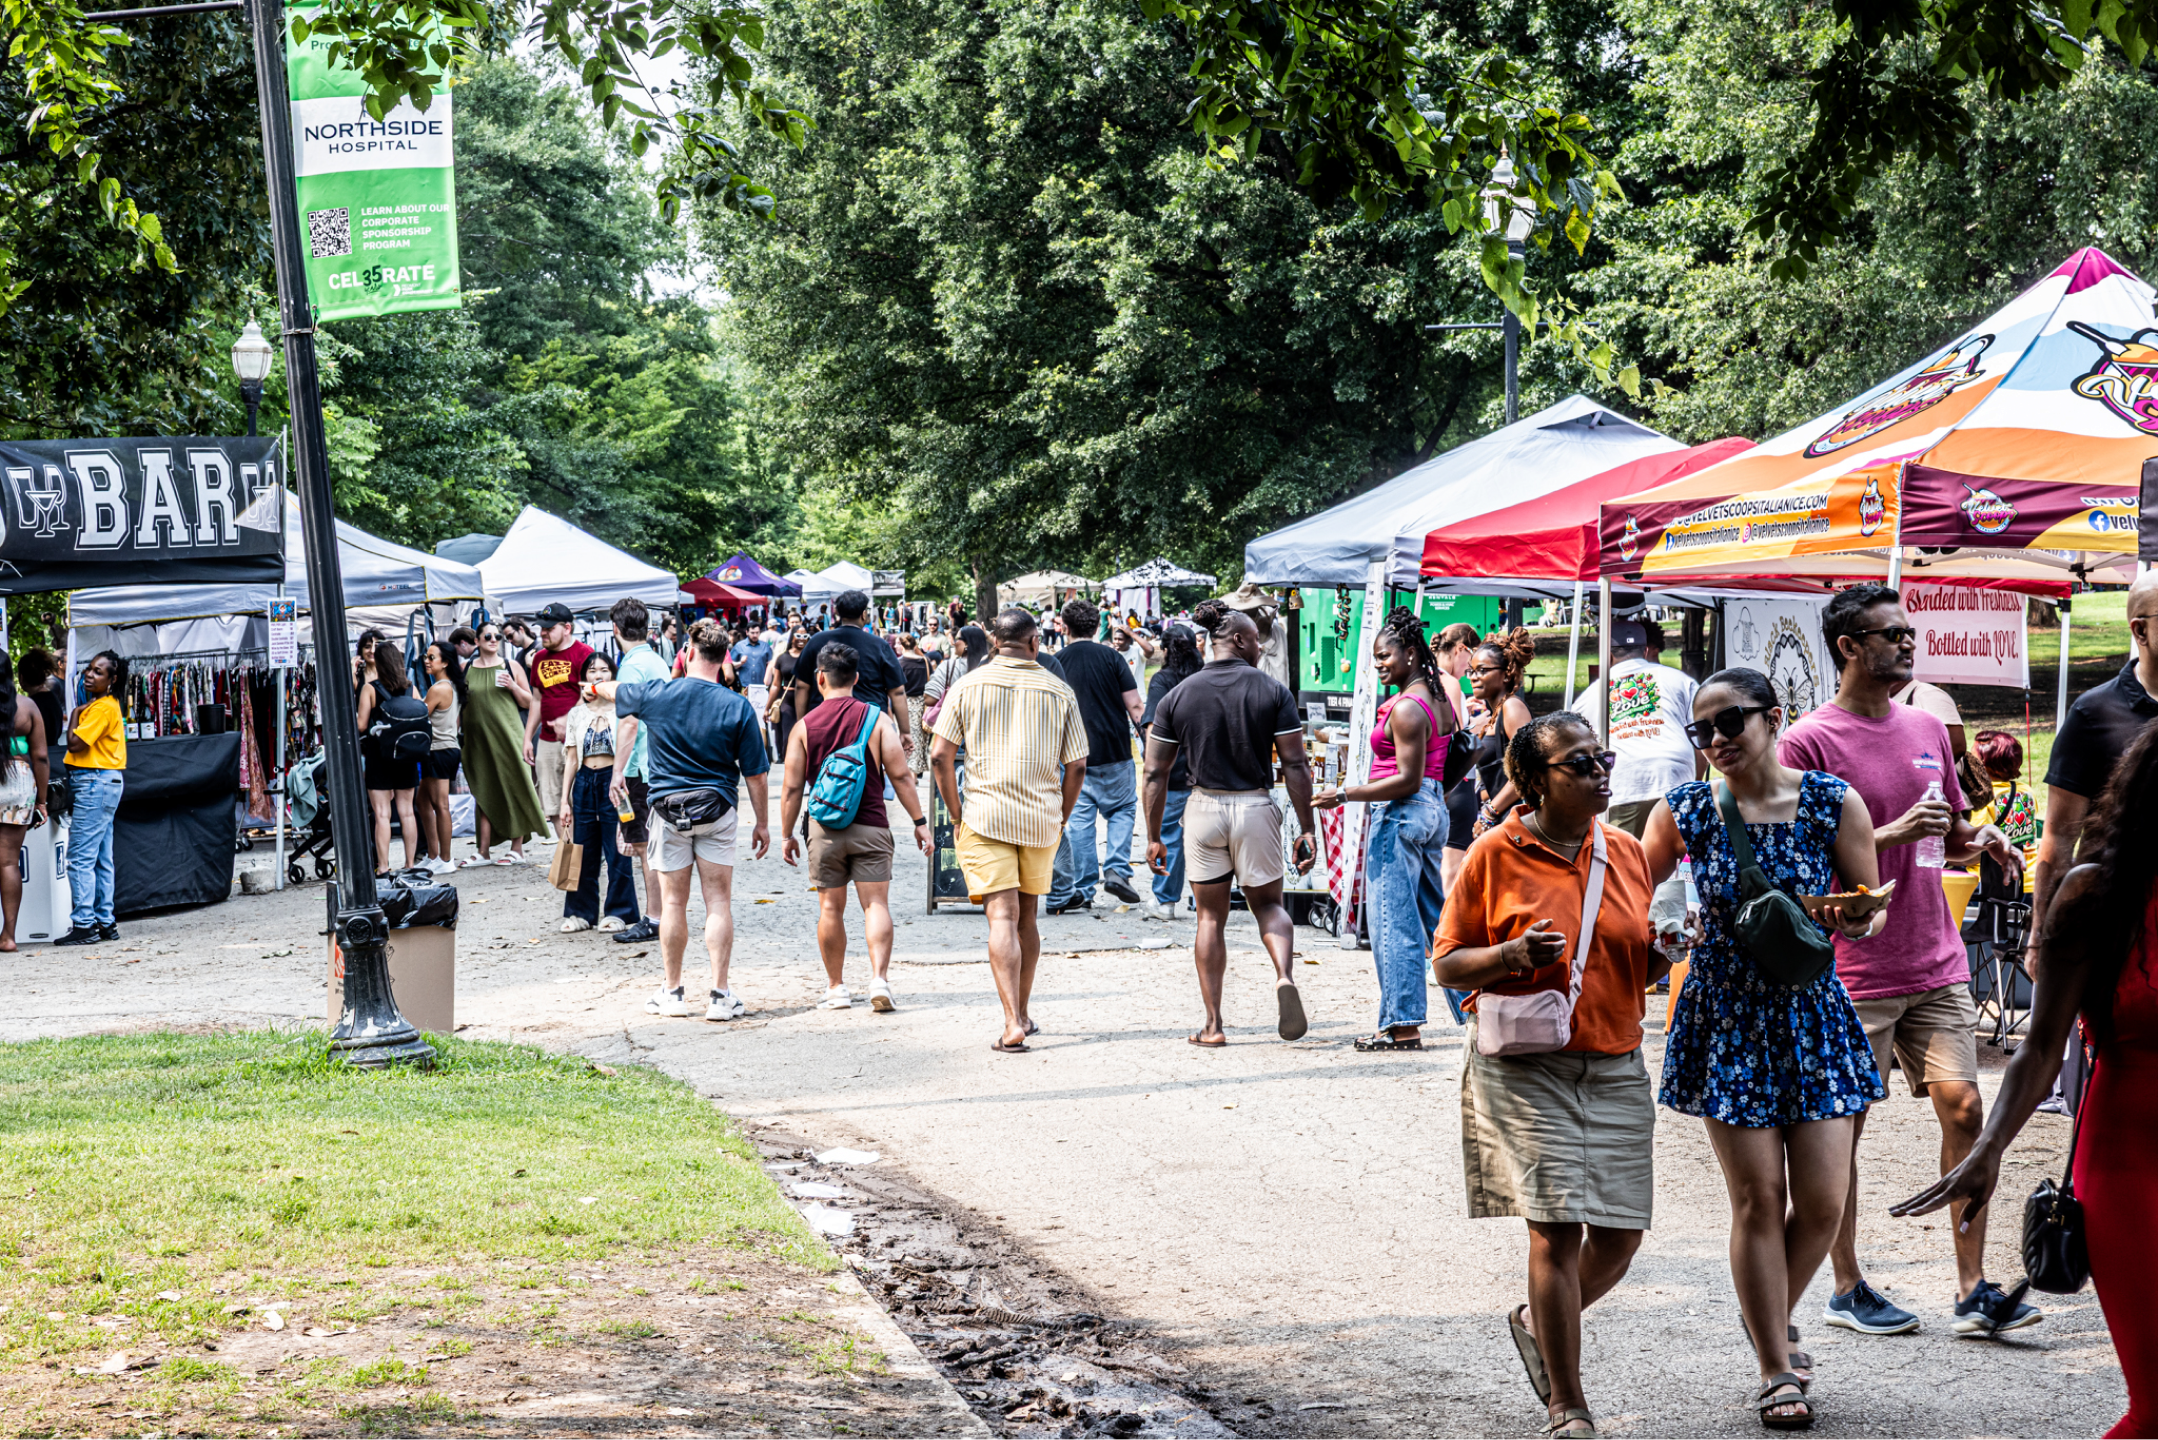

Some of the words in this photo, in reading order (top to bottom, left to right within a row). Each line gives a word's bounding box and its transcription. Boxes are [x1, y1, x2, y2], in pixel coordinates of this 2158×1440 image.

[305, 120, 443, 141] NORTHSIDE
[329, 140, 418, 154] HOSPITAL
[361, 206, 392, 215] LEARN
[395, 204, 427, 213] ABOUT
[429, 204, 450, 212] OUR
[362, 216, 419, 227] CORPORATE
[362, 227, 431, 239] SPONSORSHIP
[363, 239, 410, 250] PROGRAM
[64, 447, 240, 550] BAR
[1664, 494, 1829, 529] O@VELVETSCOOPSITALIANICE.COM
[1906, 586, 1956, 613] Blended
[1958, 587, 1979, 612] with
[1926, 630, 1969, 658] Bottled
[1970, 631, 1991, 657] with
[1611, 695, 1650, 719] Love
[2004, 824, 2033, 840] Love
